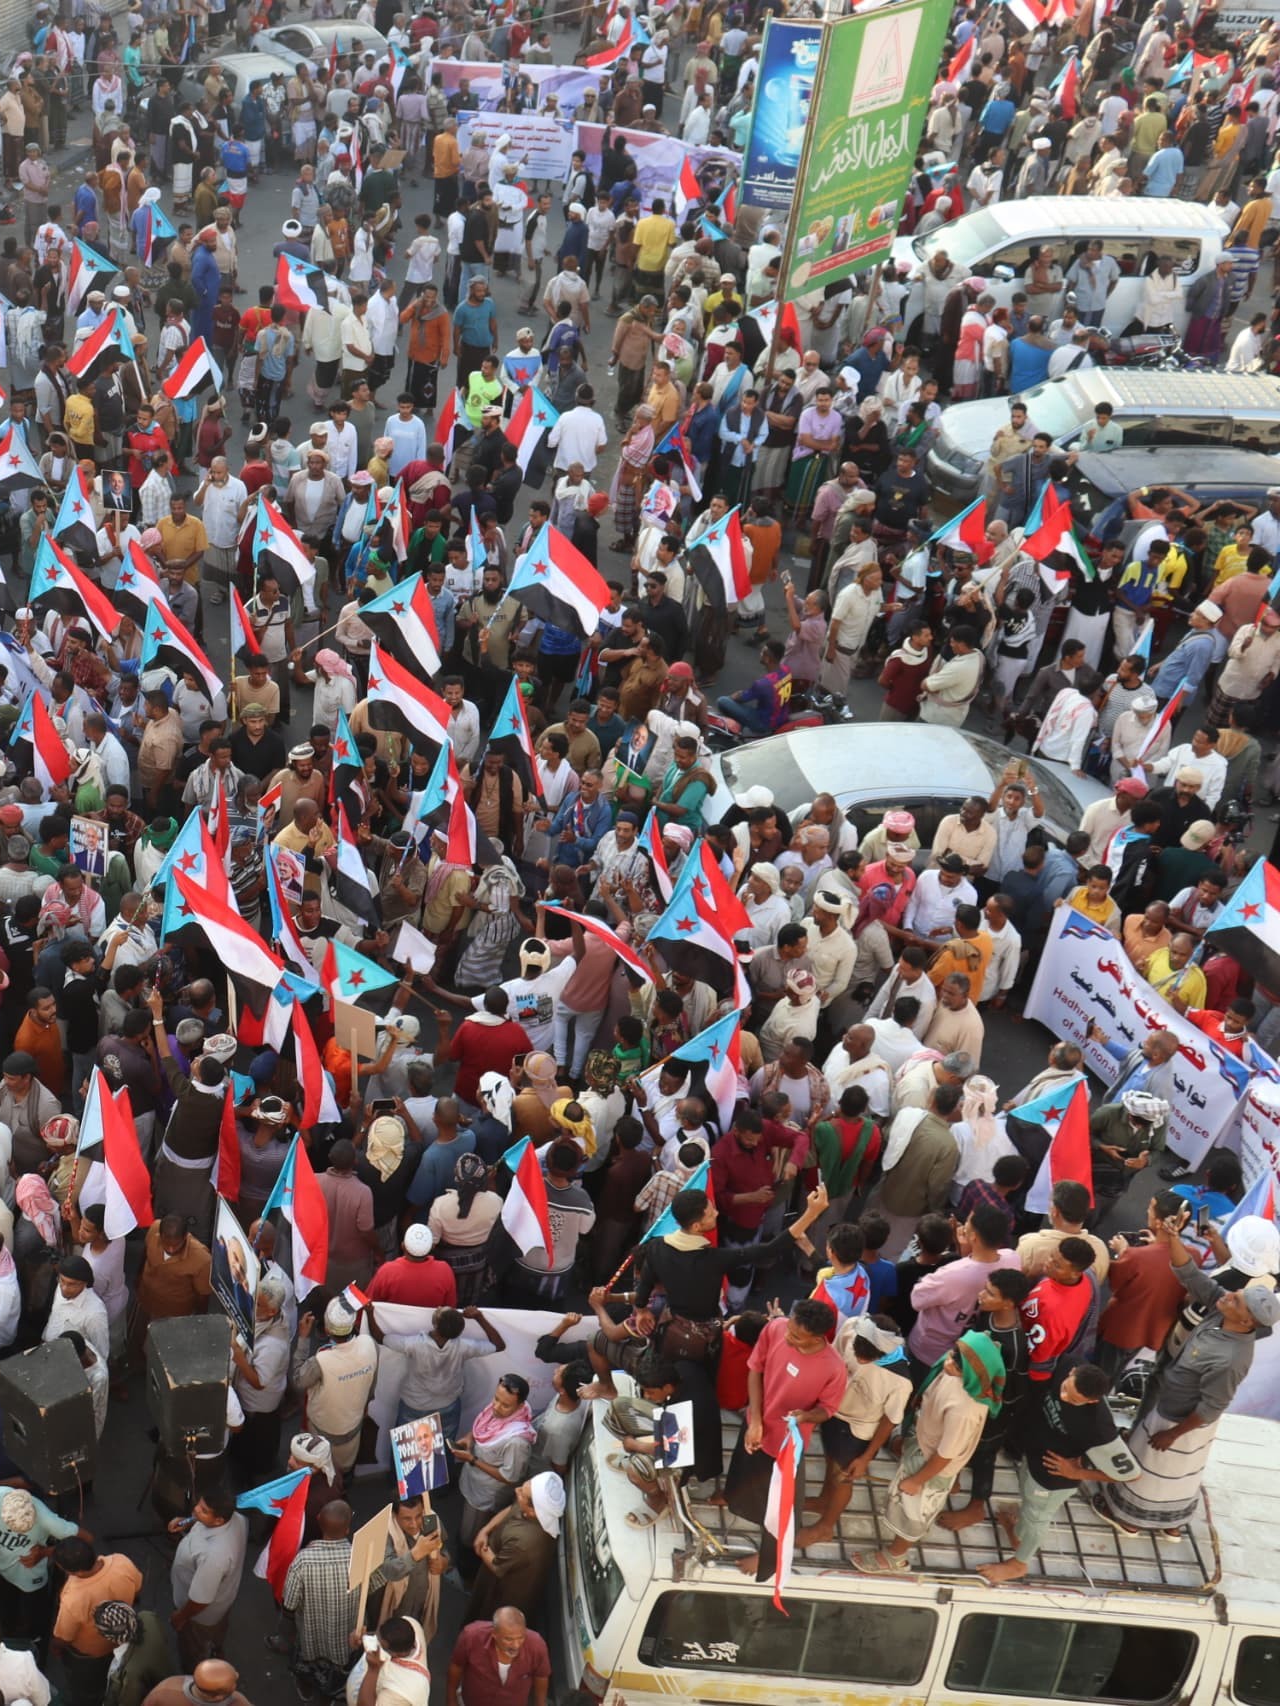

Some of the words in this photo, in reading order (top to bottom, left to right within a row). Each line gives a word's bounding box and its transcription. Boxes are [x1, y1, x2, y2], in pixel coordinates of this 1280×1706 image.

[1062, 1017, 1074, 1031] of
[1073, 1030, 1091, 1049] any
[1135, 999, 1207, 1072] حضموت
